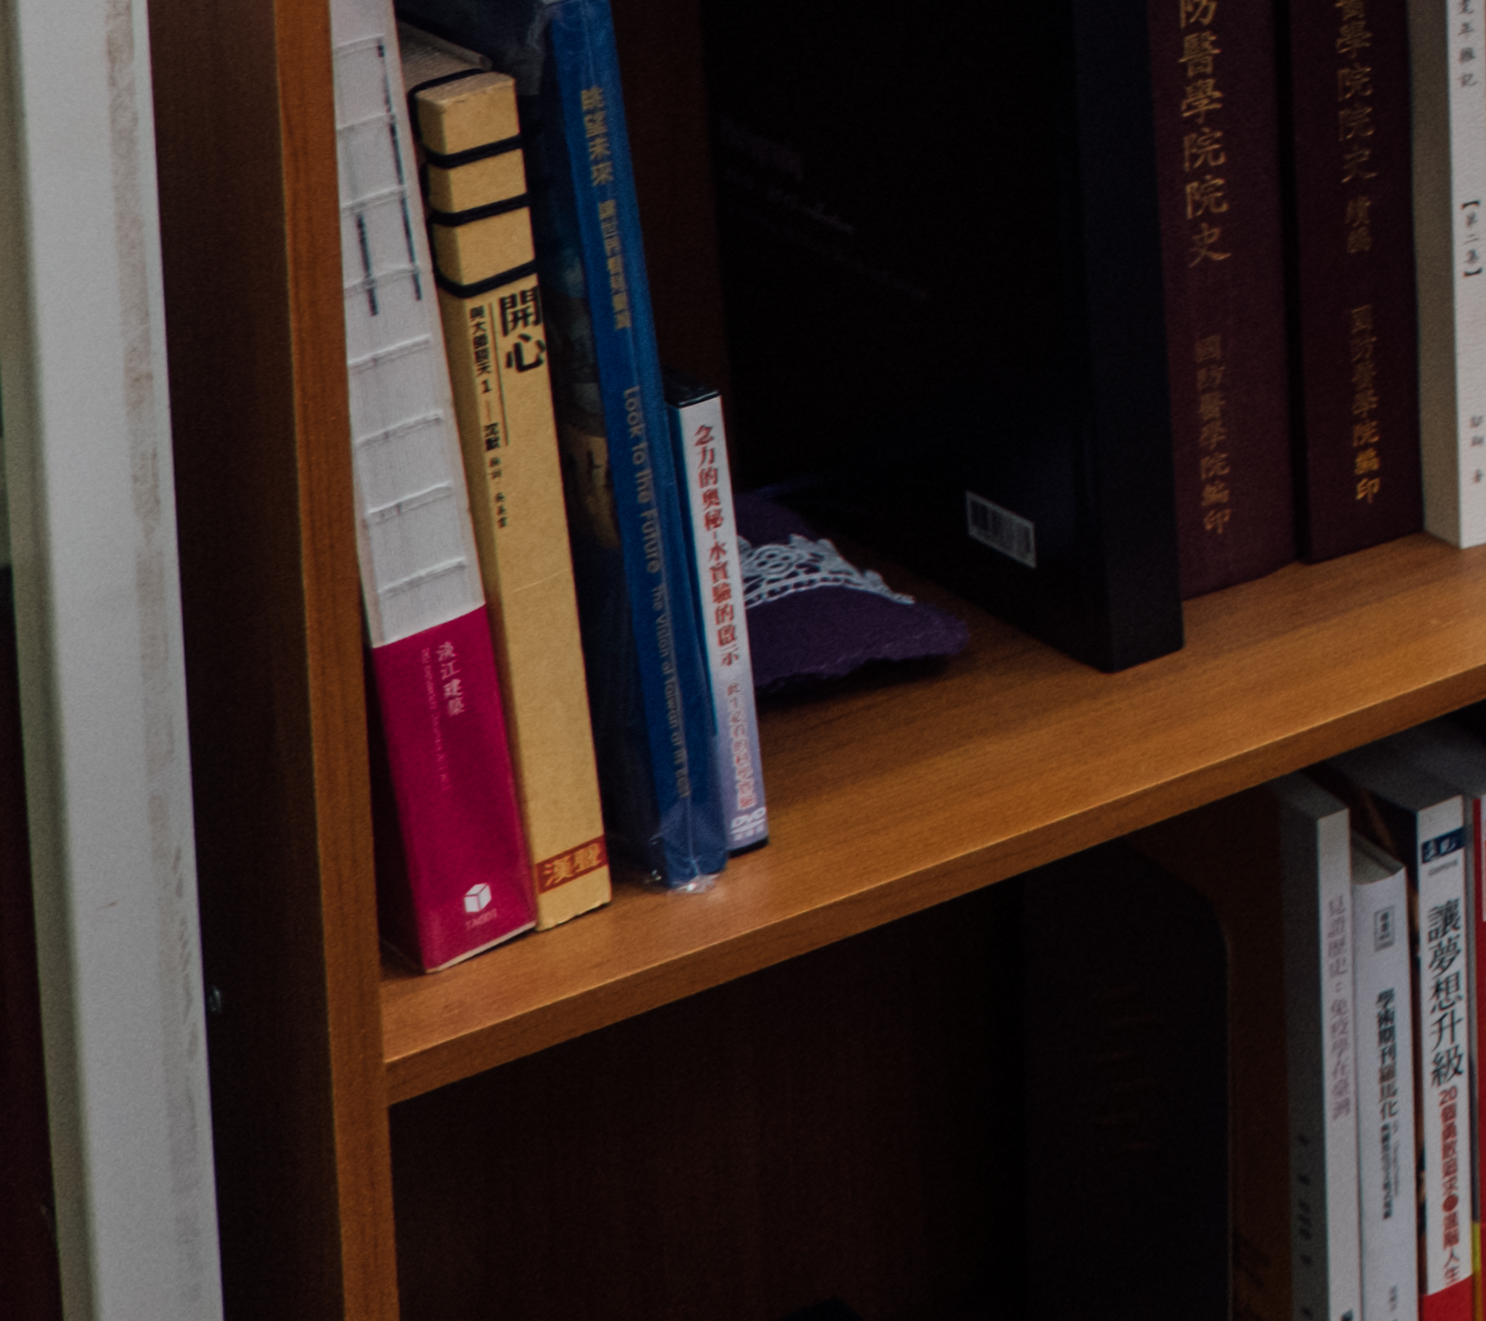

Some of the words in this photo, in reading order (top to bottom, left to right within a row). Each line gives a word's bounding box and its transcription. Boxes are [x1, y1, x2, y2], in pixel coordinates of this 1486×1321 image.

[498, 284, 548, 374] 開心
[622, 384, 646, 440] Look
[631, 441, 650, 466] to
[635, 467, 654, 505] the
[640, 506, 663, 575] Future
[1427, 897, 1465, 1088] 讓夢想升級
